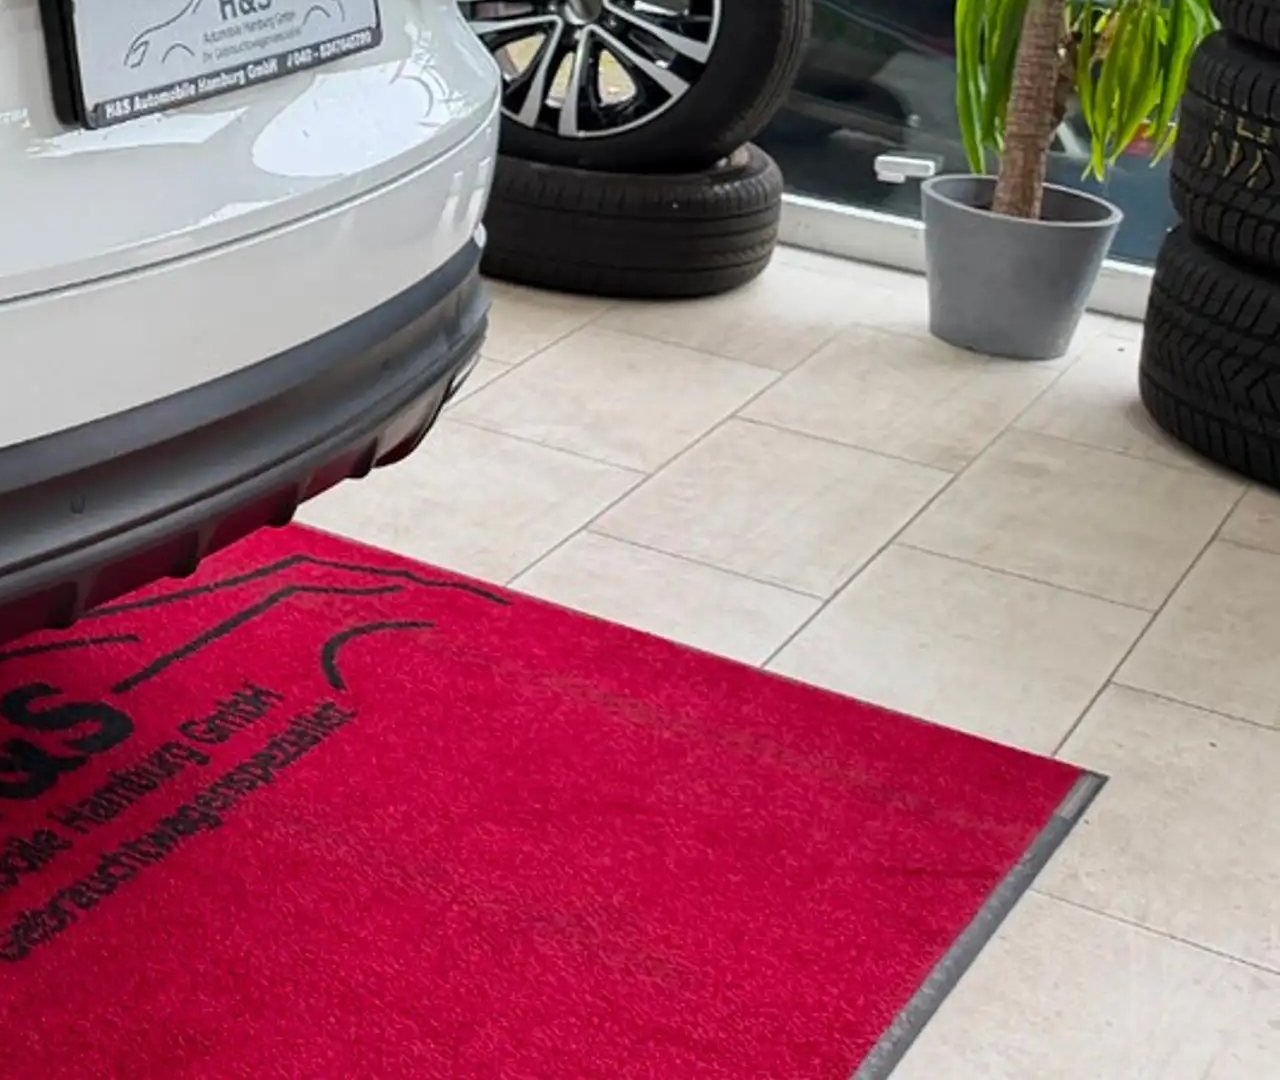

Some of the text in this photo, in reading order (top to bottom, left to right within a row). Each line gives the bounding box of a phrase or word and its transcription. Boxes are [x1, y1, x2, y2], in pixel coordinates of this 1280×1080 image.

[104, 97, 132, 120] H&S
[133, 81, 197, 112] Automobile
[198, 69, 246, 93] Hamburg
[246, 57, 279, 80] GmbH
[46, 740, 211, 835] Hamburg
[177, 677, 286, 745] GmbH
